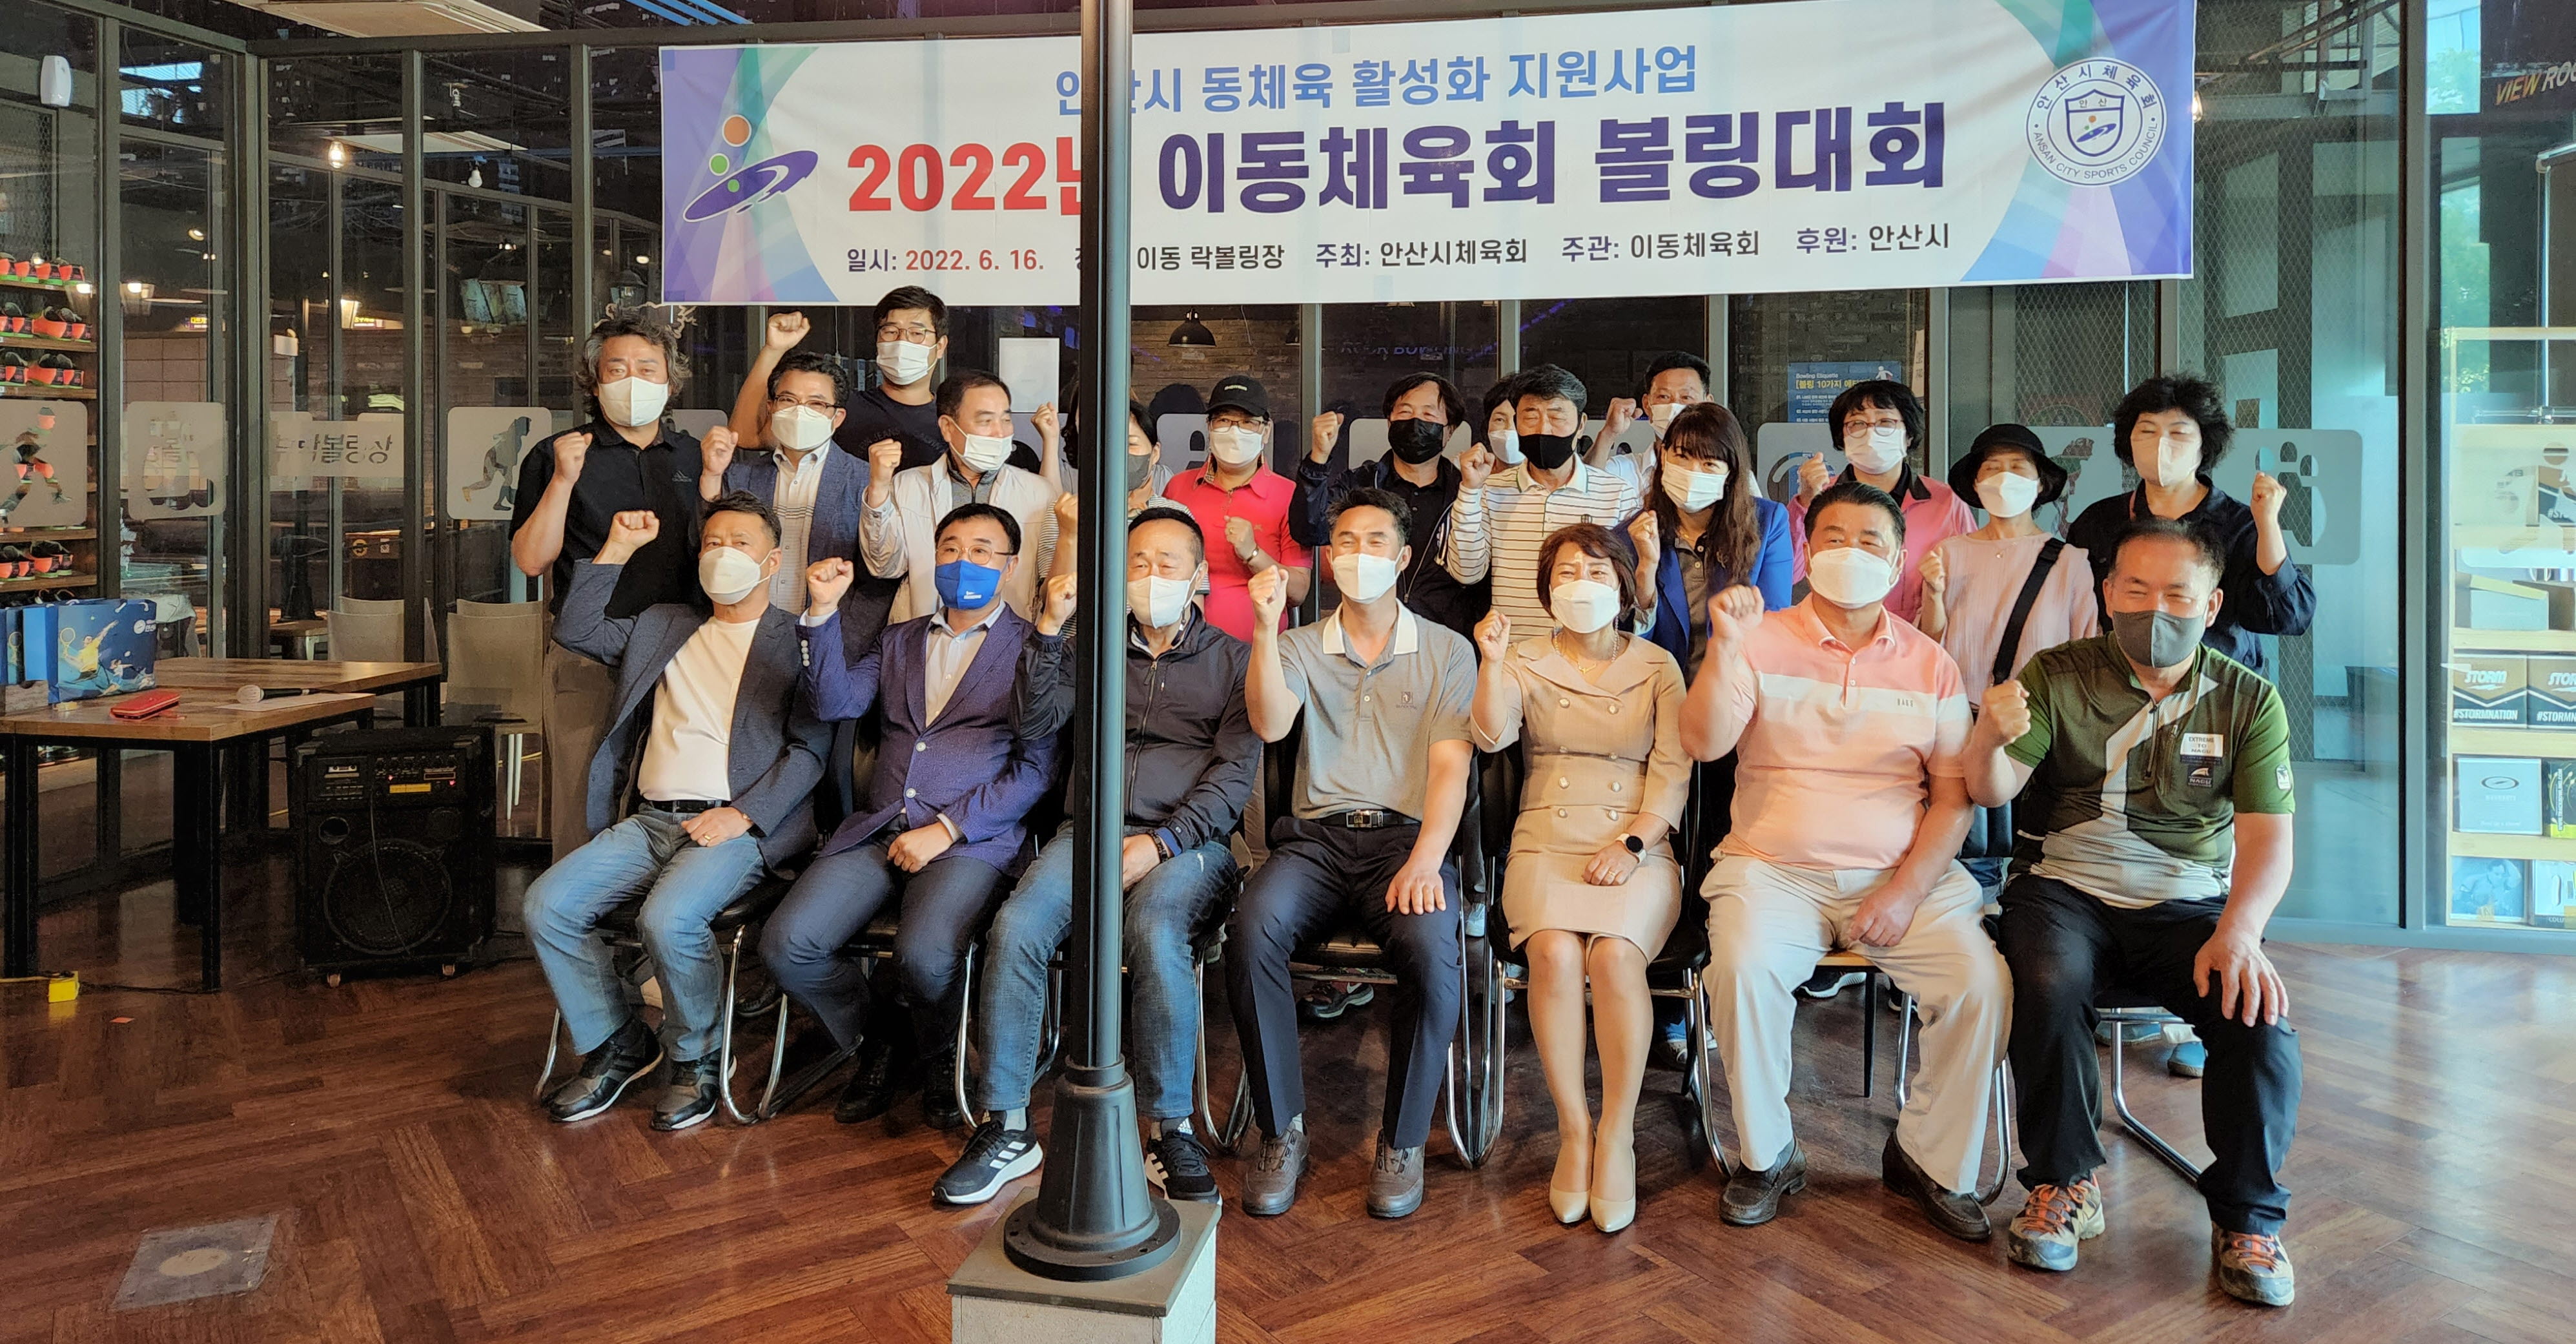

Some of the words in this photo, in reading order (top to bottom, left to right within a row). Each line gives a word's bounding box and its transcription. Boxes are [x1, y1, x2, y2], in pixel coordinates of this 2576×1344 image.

[1203, 65, 1333, 113] 동체육
[1353, 56, 1491, 107] 활성화
[1509, 46, 1695, 99] 지원사업
[2036, 63, 2158, 110] 안산시체육회
[2495, 72, 2542, 105] VIEW
[1159, 120, 1556, 214] 이동체육회
[1595, 101, 1946, 203] 볼링대회
[2034, 132, 2056, 164] ANSAN
[2056, 162, 2080, 178] CITY
[2083, 164, 2128, 180] SPORTS
[2129, 123, 2158, 167] COUNCIL
[848, 249, 897, 273] 일시:
[906, 250, 970, 271] 2022.
[979, 250, 1000, 271] 6.
[1010, 249, 1044, 271] 16.
[1138, 246, 1181, 271] 이동
[1192, 245, 1285, 271] 락볼링장
[1316, 243, 1370, 269] 주최:
[1381, 238, 1527, 267] 안산시체육회
[1562, 236, 1620, 263] 주관:
[1631, 231, 1759, 260] 이동체육회
[1797, 227, 1857, 255] 후원:
[1870, 223, 1949, 253] 안산시
[1817, 380, 1842, 389] 10가지
[2464, 670, 2508, 683] STORM
[2453, 708, 2518, 720] #STORMNATION
